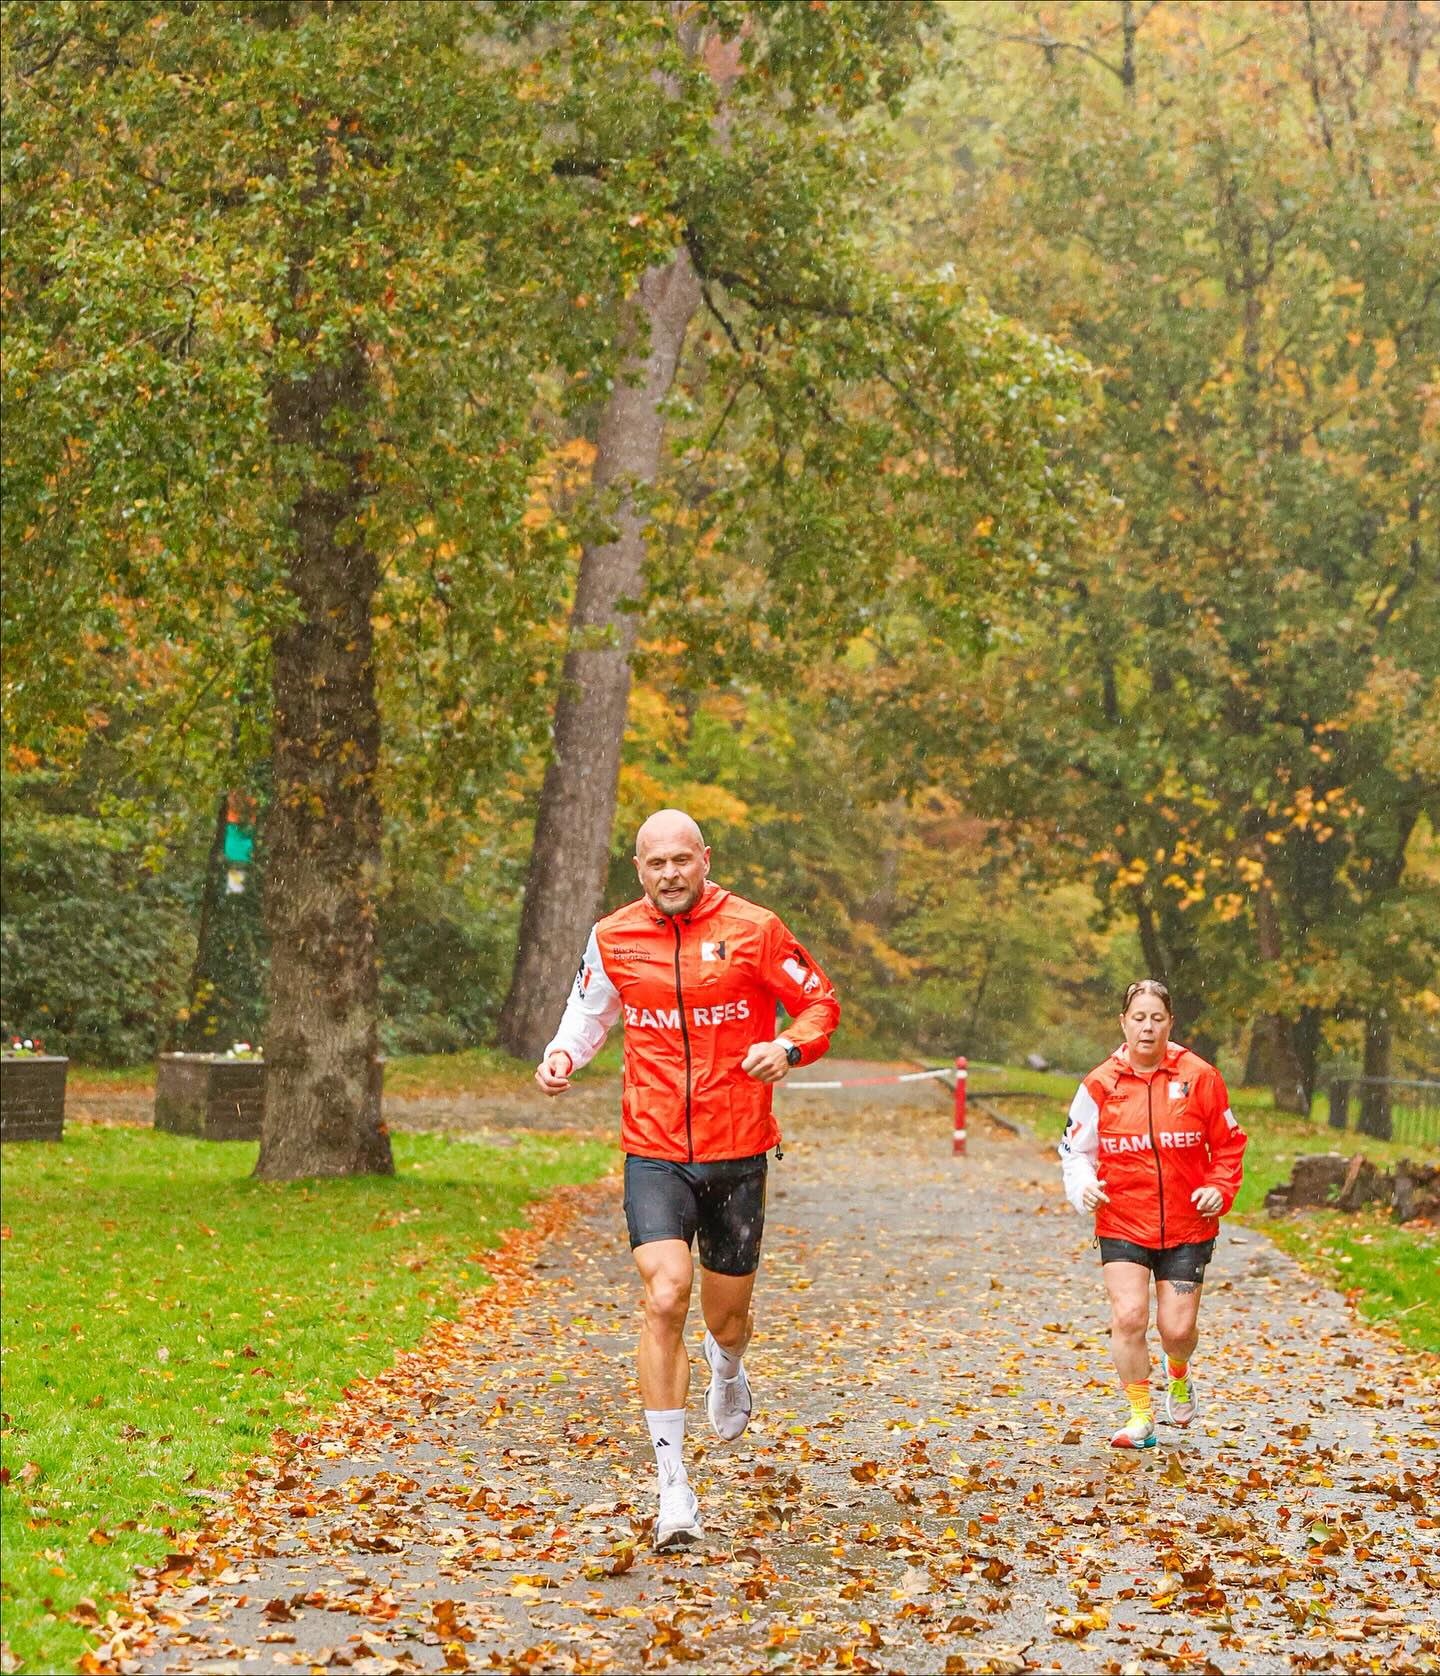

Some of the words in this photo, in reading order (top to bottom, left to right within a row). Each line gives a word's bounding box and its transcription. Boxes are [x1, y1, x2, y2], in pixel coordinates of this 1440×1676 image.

[624, 1003, 681, 1030] TEAM
[693, 999, 750, 1027] REES
[1101, 1134, 1153, 1154] TEAM
[1159, 1131, 1202, 1149] REES
